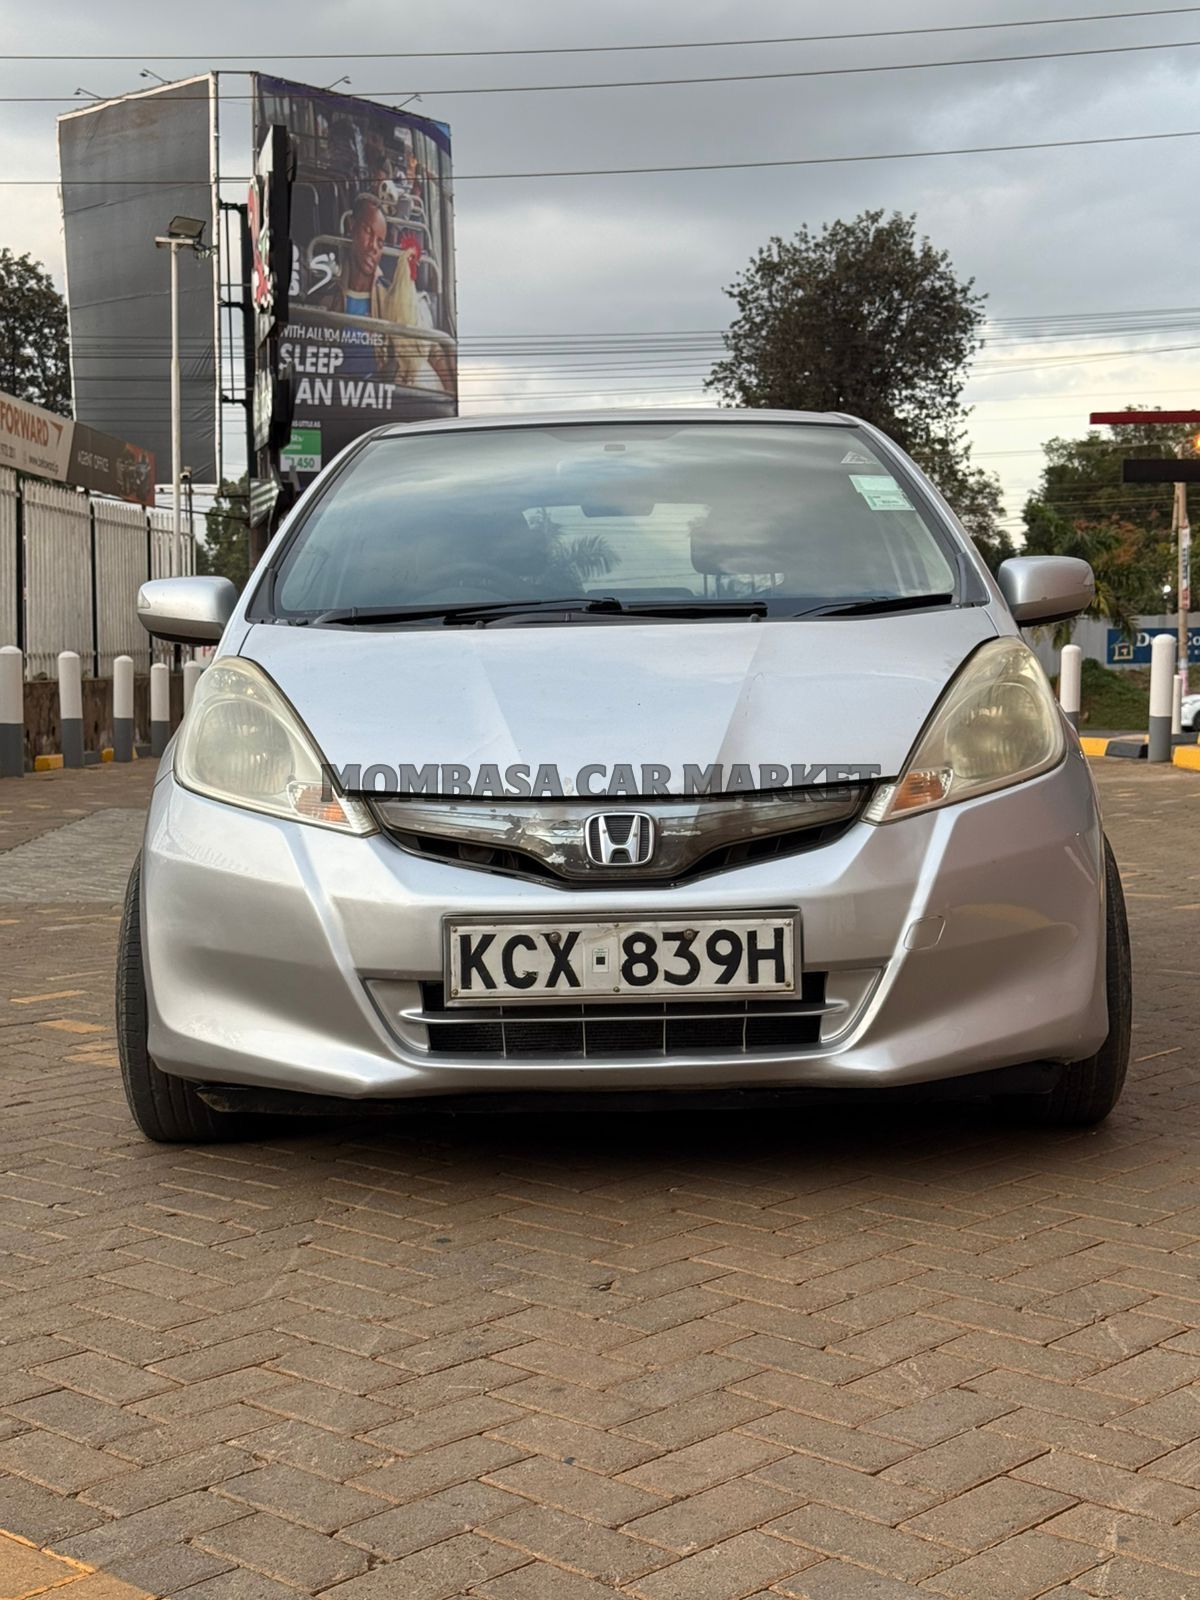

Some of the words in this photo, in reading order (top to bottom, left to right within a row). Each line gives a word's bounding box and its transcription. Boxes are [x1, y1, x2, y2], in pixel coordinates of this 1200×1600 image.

[306, 326, 323, 341] ALL
[324, 328, 340, 342] 104
[279, 343, 344, 375] SLEEP
[295, 378, 333, 406] AN
[339, 379, 396, 411] WAIT
[0, 401, 49, 447] FORWARD
[459, 931, 582, 989] KCX
[621, 927, 786, 986] 839H
